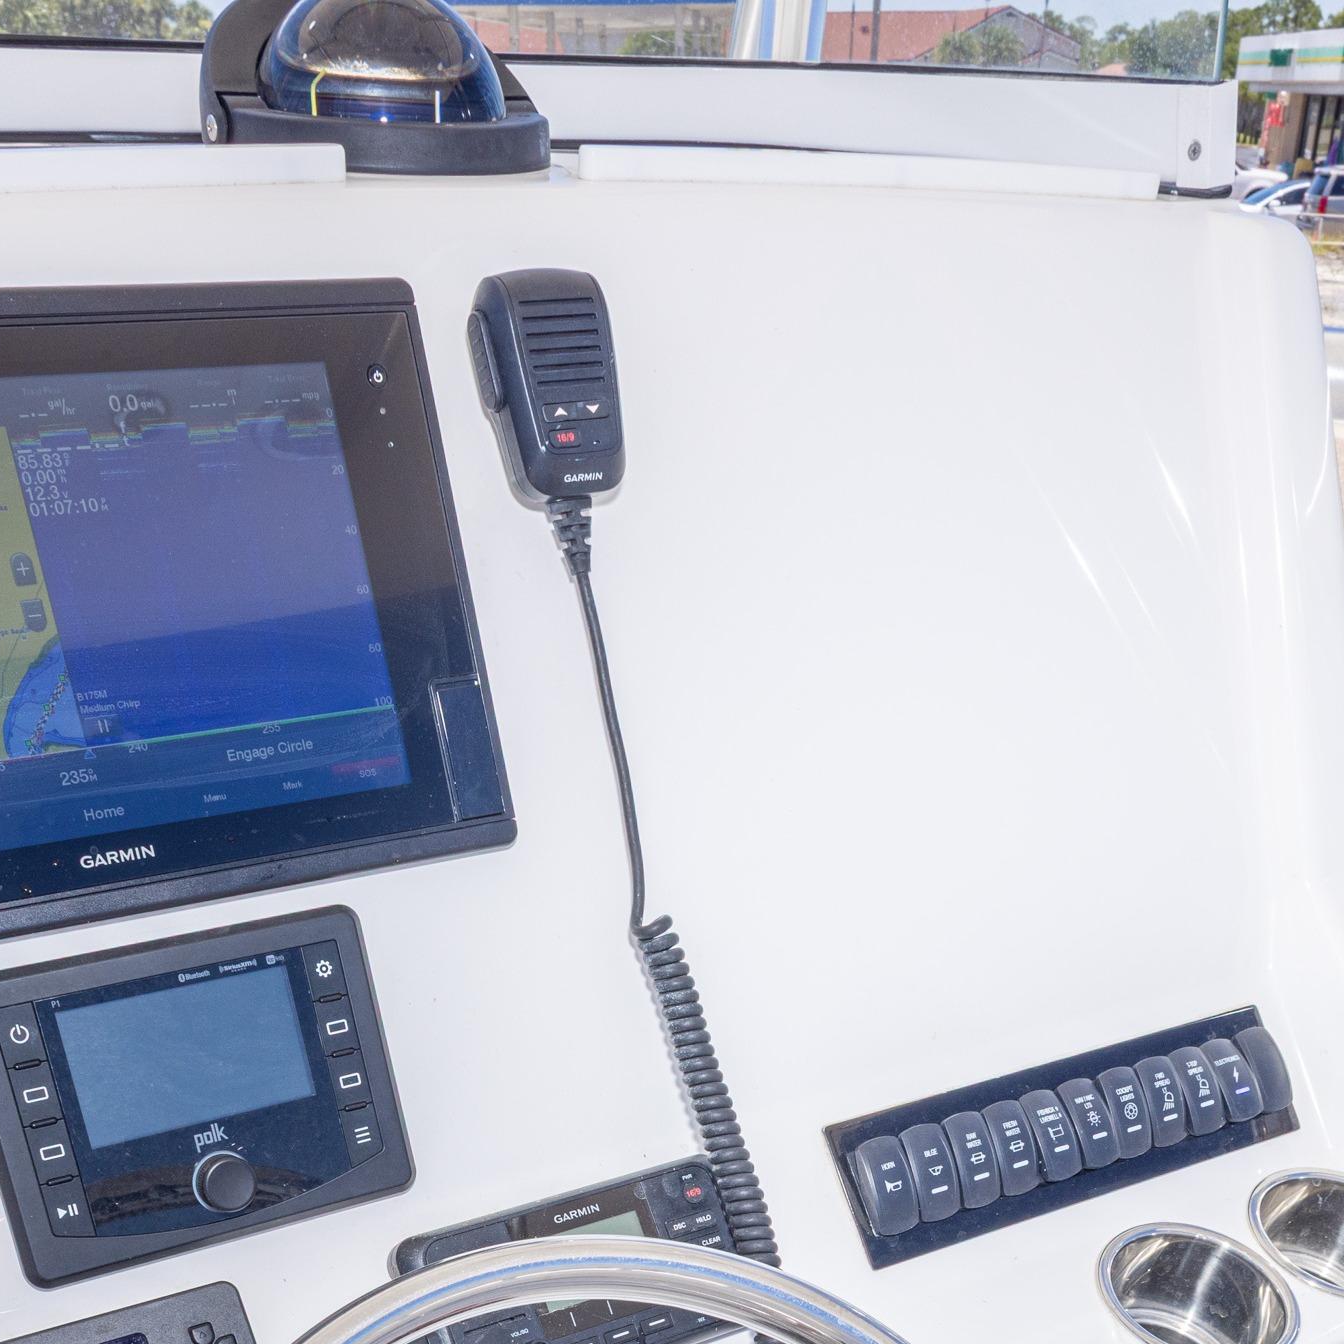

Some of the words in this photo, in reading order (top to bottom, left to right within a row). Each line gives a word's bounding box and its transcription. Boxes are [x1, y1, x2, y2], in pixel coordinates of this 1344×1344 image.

[108, 394, 138, 412] 0.0
[556, 432, 575, 442] 16/9
[18, 454, 62, 470] 85.83
[330, 464, 344, 475] 20
[22, 470, 56, 485] 0.00
[564, 472, 603, 484] GARMIN
[25, 486, 60, 500] 12.3
[30, 498, 98, 517] 01:07:10
[345, 525, 357, 535] 40
[356, 584, 369, 594] 60
[375, 696, 392, 706] 100
[79, 703, 116, 714] Medium
[262, 723, 281, 734] 255
[226, 744, 274, 762] Engage
[277, 739, 314, 754] Circle
[60, 770, 88, 786] 235
[359, 768, 376, 778] SOS
[282, 780, 303, 791] Mark
[204, 792, 227, 804] Menu
[83, 806, 125, 822] Home
[80, 844, 156, 869] GARMIN
[1002, 1120, 1018, 1130] FRESH
[194, 1122, 229, 1152] polk
[1004, 1128, 1021, 1137] WATER
[966, 1139, 982, 1148] WATER
[880, 1161, 896, 1171] HORN
[554, 1203, 600, 1224] GARMIN
[673, 1222, 686, 1231] DSC
[702, 1236, 720, 1246] CLEAR
